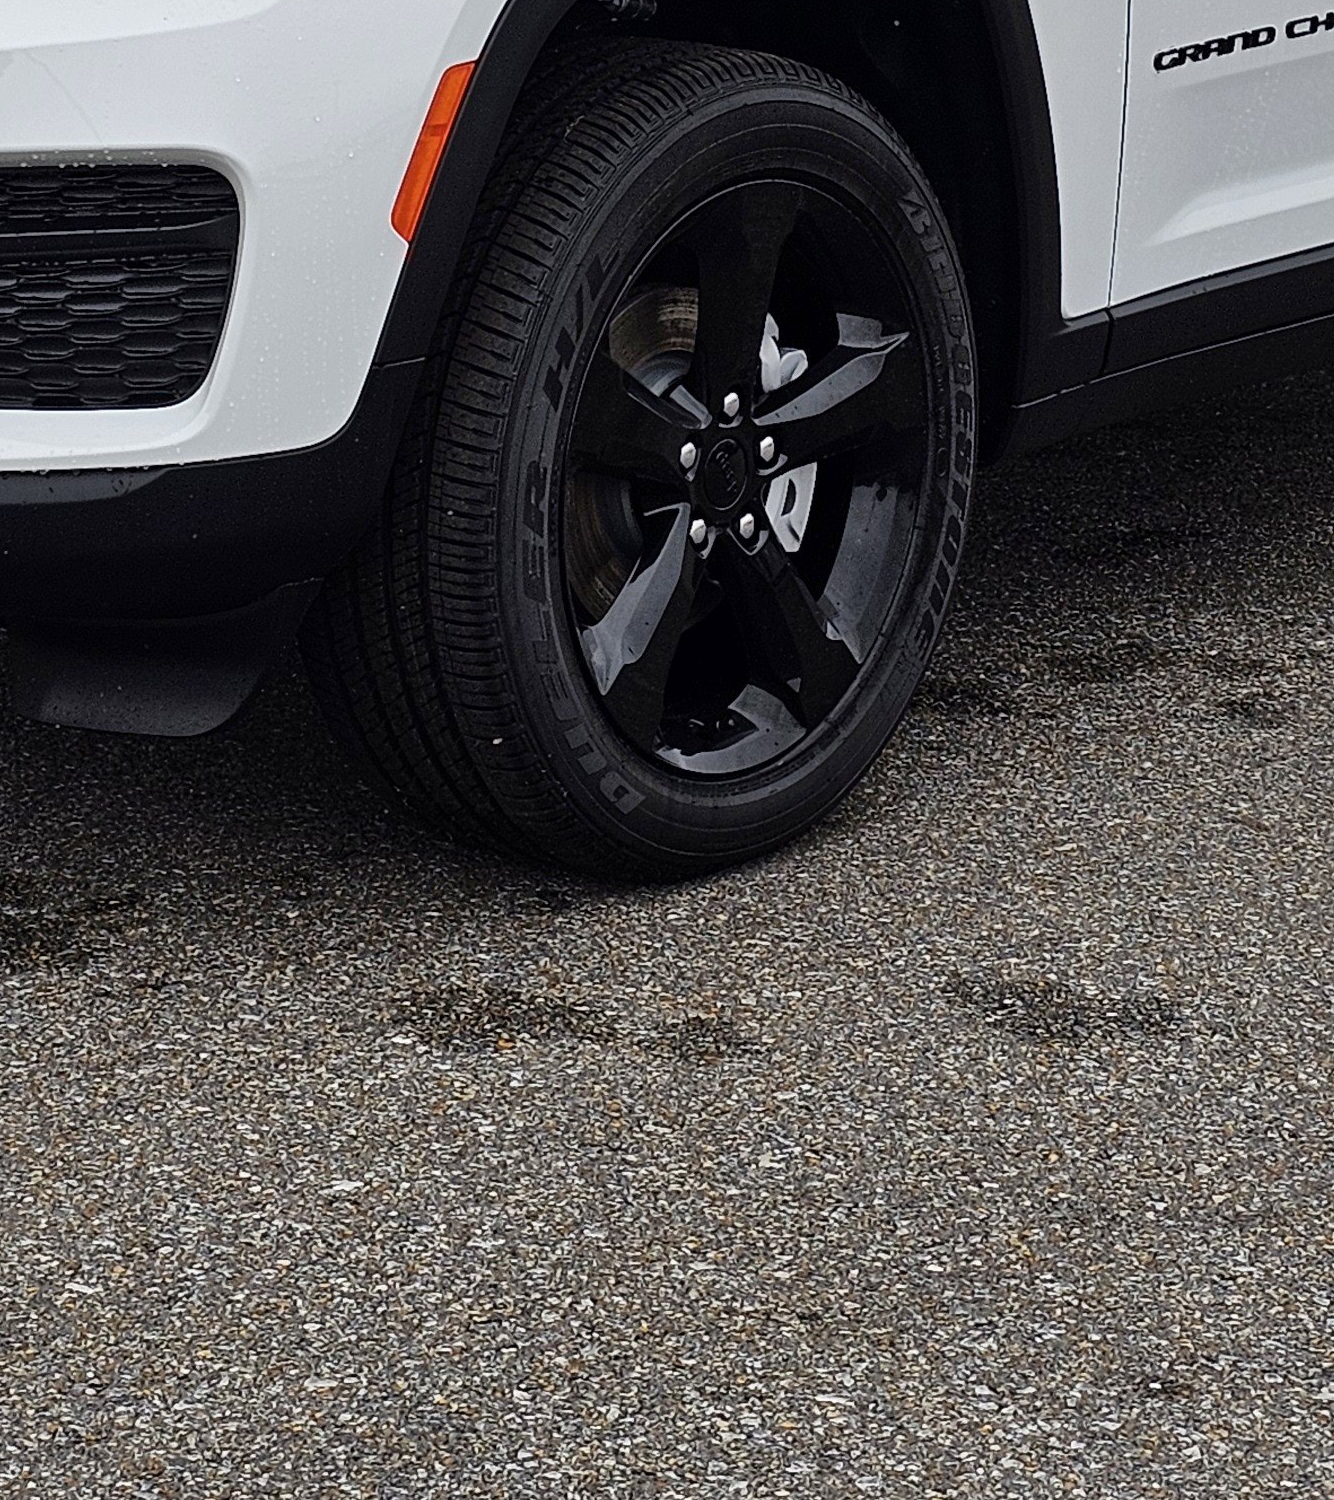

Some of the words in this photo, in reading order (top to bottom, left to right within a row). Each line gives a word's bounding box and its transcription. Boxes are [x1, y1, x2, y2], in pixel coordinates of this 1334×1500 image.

[1153, 26, 1276, 71] GRAND
[540, 248, 621, 412] H/L
[899, 190, 974, 660] BRIDGESTONE
[521, 458, 648, 816] DUELER
